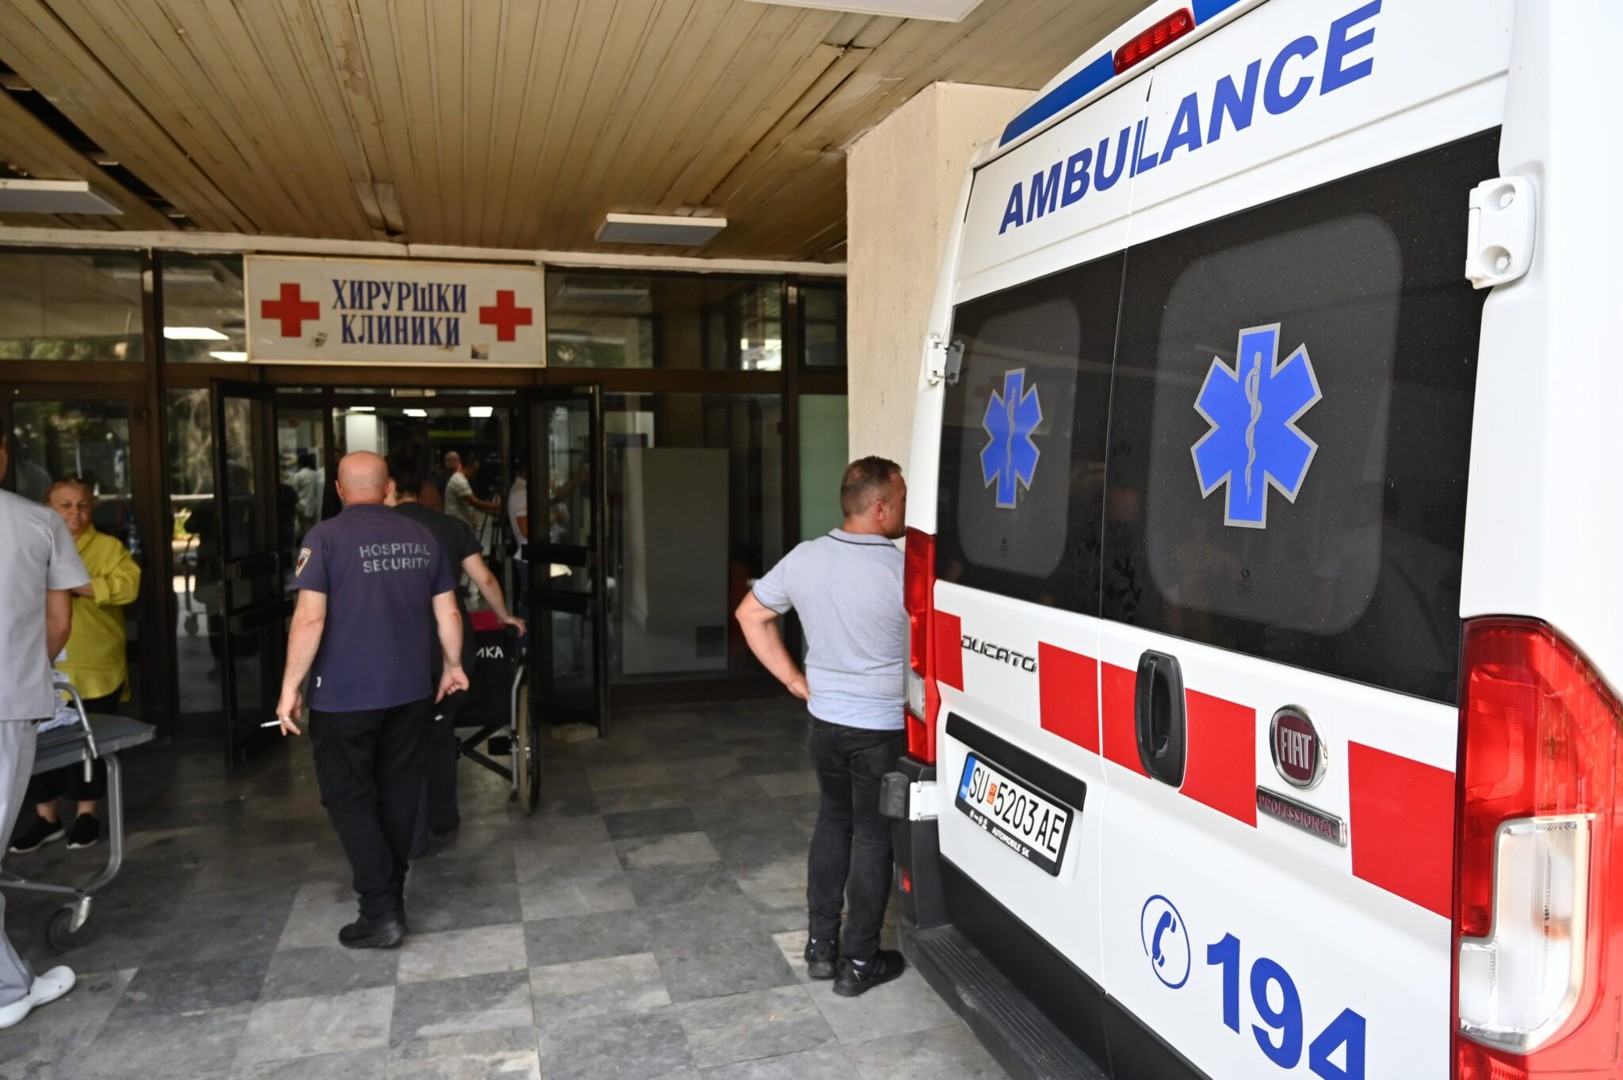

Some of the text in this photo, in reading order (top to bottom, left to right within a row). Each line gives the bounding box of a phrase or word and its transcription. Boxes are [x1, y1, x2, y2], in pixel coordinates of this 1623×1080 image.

[998, 0, 1382, 236] AMBULANCE
[331, 278, 467, 314] ХИРУРШКИ
[340, 313, 461, 347] КЛИНИКИ
[359, 542, 431, 559] HOSPITAL
[362, 556, 430, 574] SECURITY
[960, 634, 1038, 674] DUCATO
[1280, 725, 1312, 771] FIAT
[1260, 795, 1337, 839] PROFESSIONAL
[991, 826, 1021, 853] AUTOMOBILE
[1206, 931, 1366, 1080] 194
